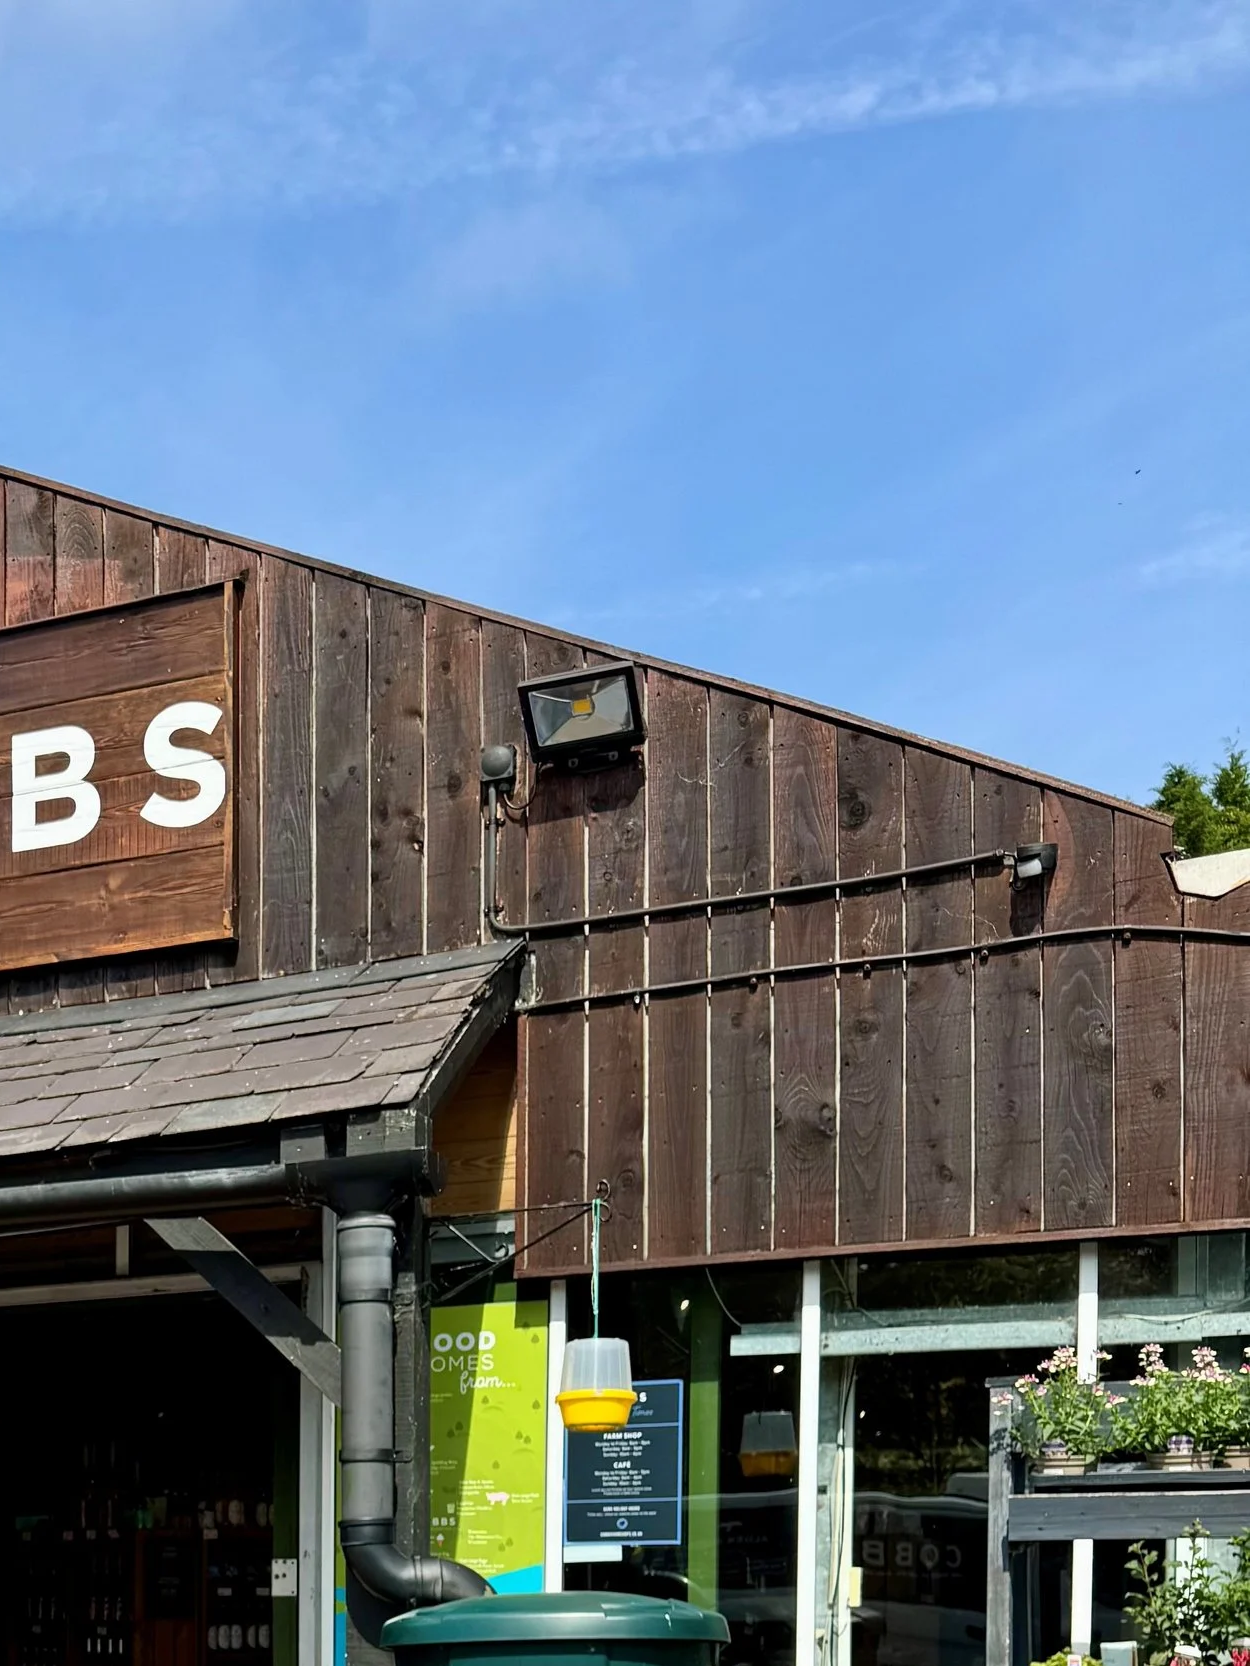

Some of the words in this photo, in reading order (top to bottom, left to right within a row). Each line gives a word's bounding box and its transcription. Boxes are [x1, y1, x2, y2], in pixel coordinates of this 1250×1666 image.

[433, 1331, 496, 1352] OOD
[431, 1354, 494, 1372] OMES
[603, 1432, 622, 1440] FARM
[624, 1431, 642, 1439] SHOP
[432, 1517, 456, 1527] BBS
